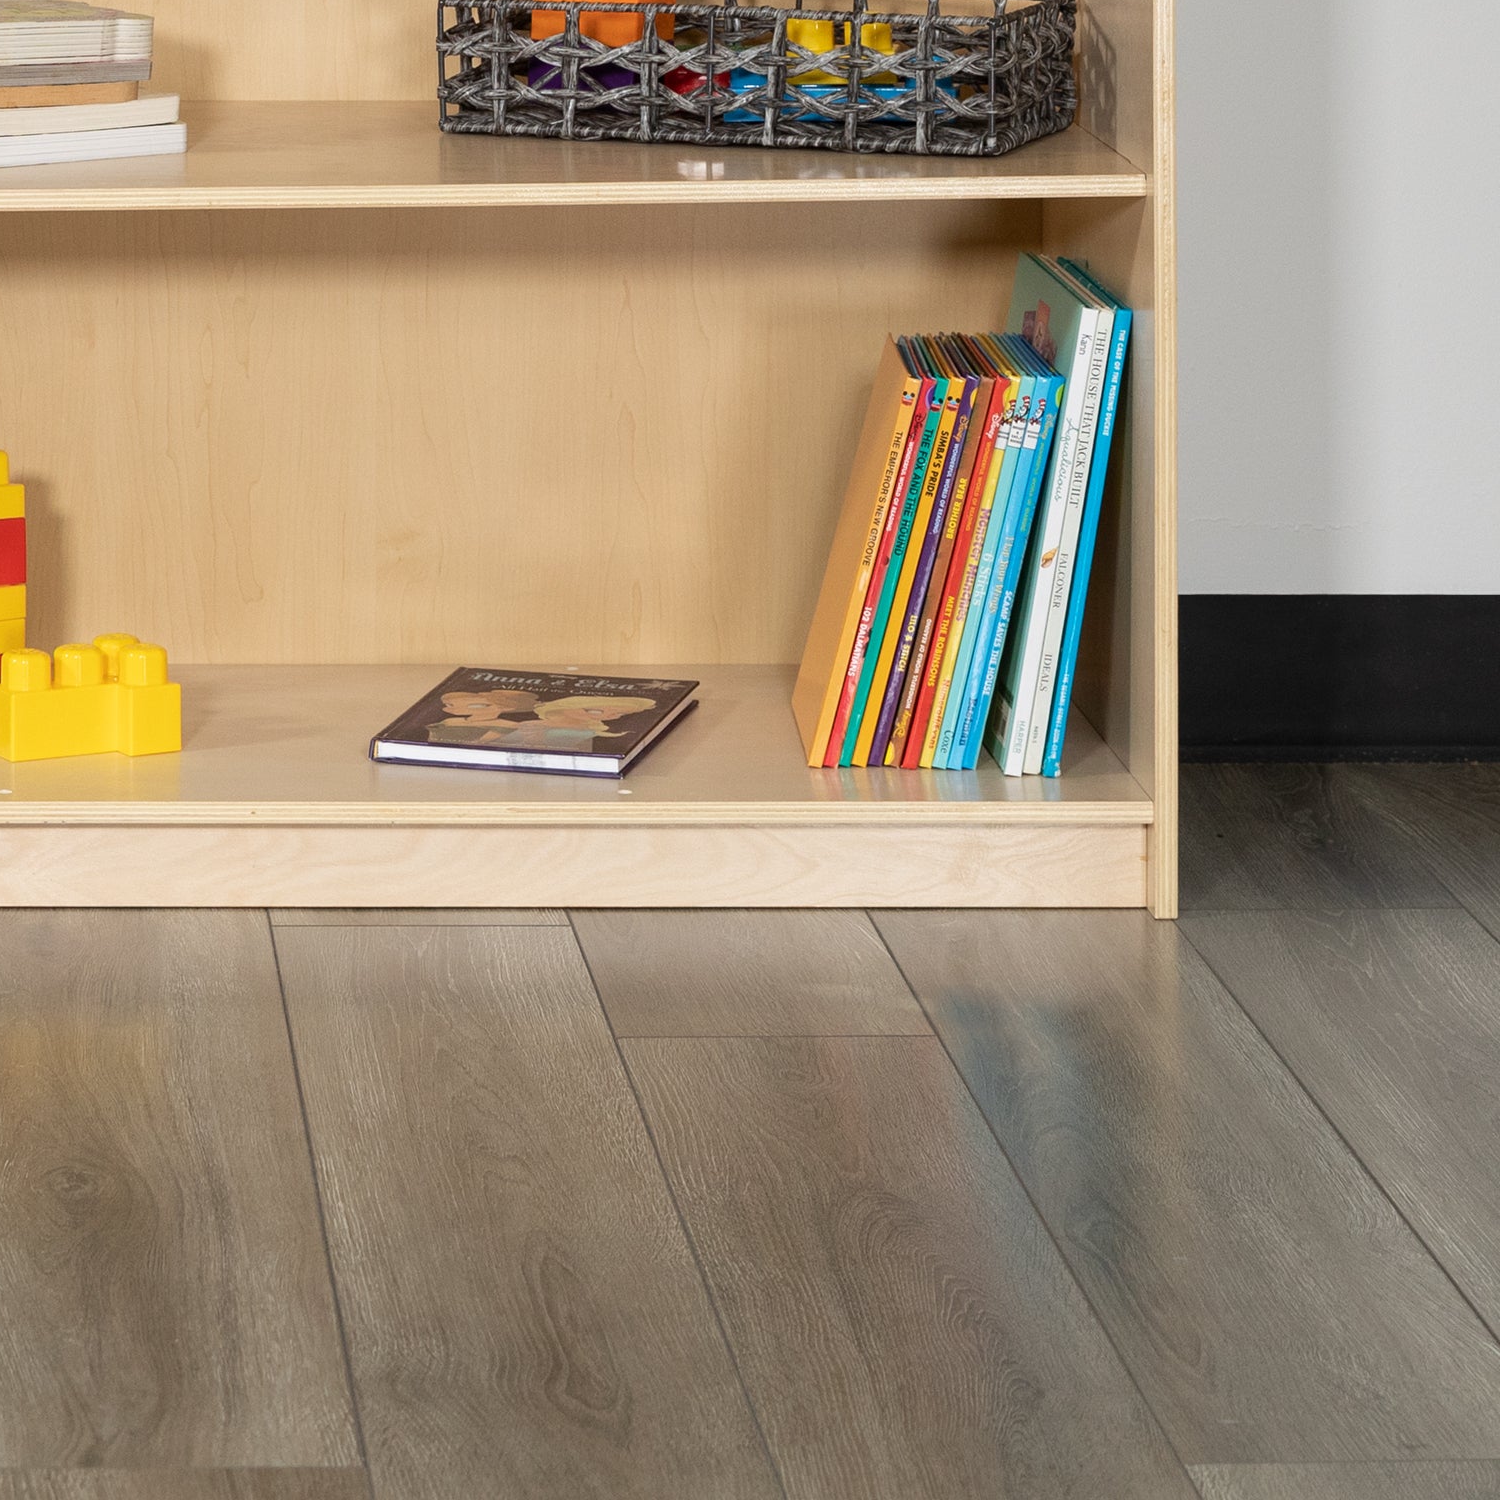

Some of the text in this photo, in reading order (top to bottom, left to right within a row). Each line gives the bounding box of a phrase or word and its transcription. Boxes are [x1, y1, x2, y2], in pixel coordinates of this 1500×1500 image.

[1079, 334, 1092, 355] Kann
[1113, 361, 1120, 371] OF
[1115, 343, 1123, 359] CASE
[1069, 331, 1107, 507] THE HOUSE THAT JACK BUILT
[1106, 385, 1116, 412] MISSING
[925, 431, 949, 497] SIMBA'S PRIDE
[1054, 418, 1079, 502] Aqualicious
[863, 432, 903, 565] THE EMPEROR'S NEW GROOVE
[894, 429, 933, 556] THE FOX AND THE HOUND
[945, 477, 968, 540] BROTHER BEAR
[956, 507, 991, 621] Monster Munchies
[973, 553, 993, 607] 6 Sticks
[1053, 553, 1068, 609] FALCONER
[848, 606, 872, 677] 102 DALMATIANS
[927, 596, 954, 688] MEET THE ROBINSONS
[982, 591, 1013, 695] SCAMP SAVES THE HOUSE
[470, 672, 541, 686] Anna
[574, 678, 636, 691] Elsa
[1040, 654, 1052, 692] IDEALS
[941, 729, 954, 754] Coxe
[1013, 720, 1026, 754] HARPER
